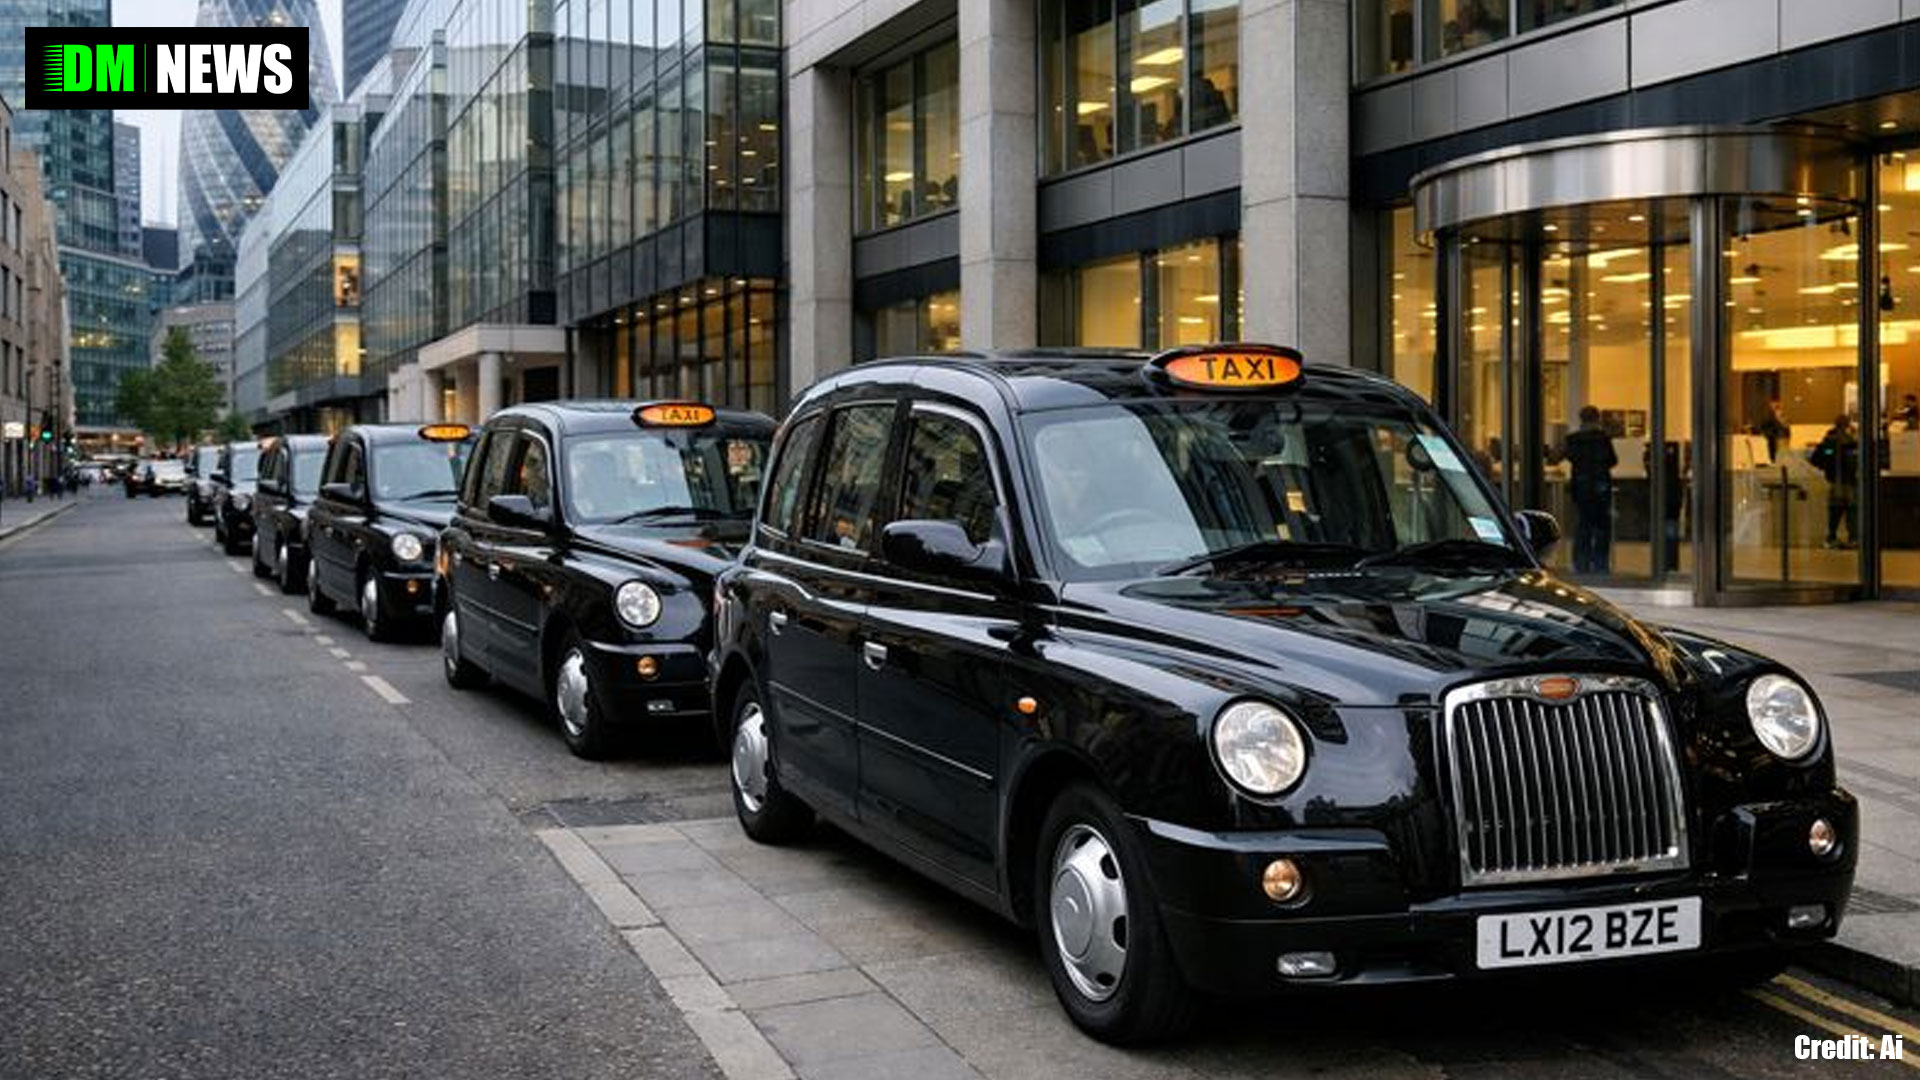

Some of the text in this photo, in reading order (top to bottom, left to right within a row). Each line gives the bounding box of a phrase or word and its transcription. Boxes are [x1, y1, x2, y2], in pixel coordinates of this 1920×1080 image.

[1198, 357, 1275, 380] TAXI
[661, 408, 700, 421] TAXI
[1500, 905, 1679, 959] LX12 BZE
